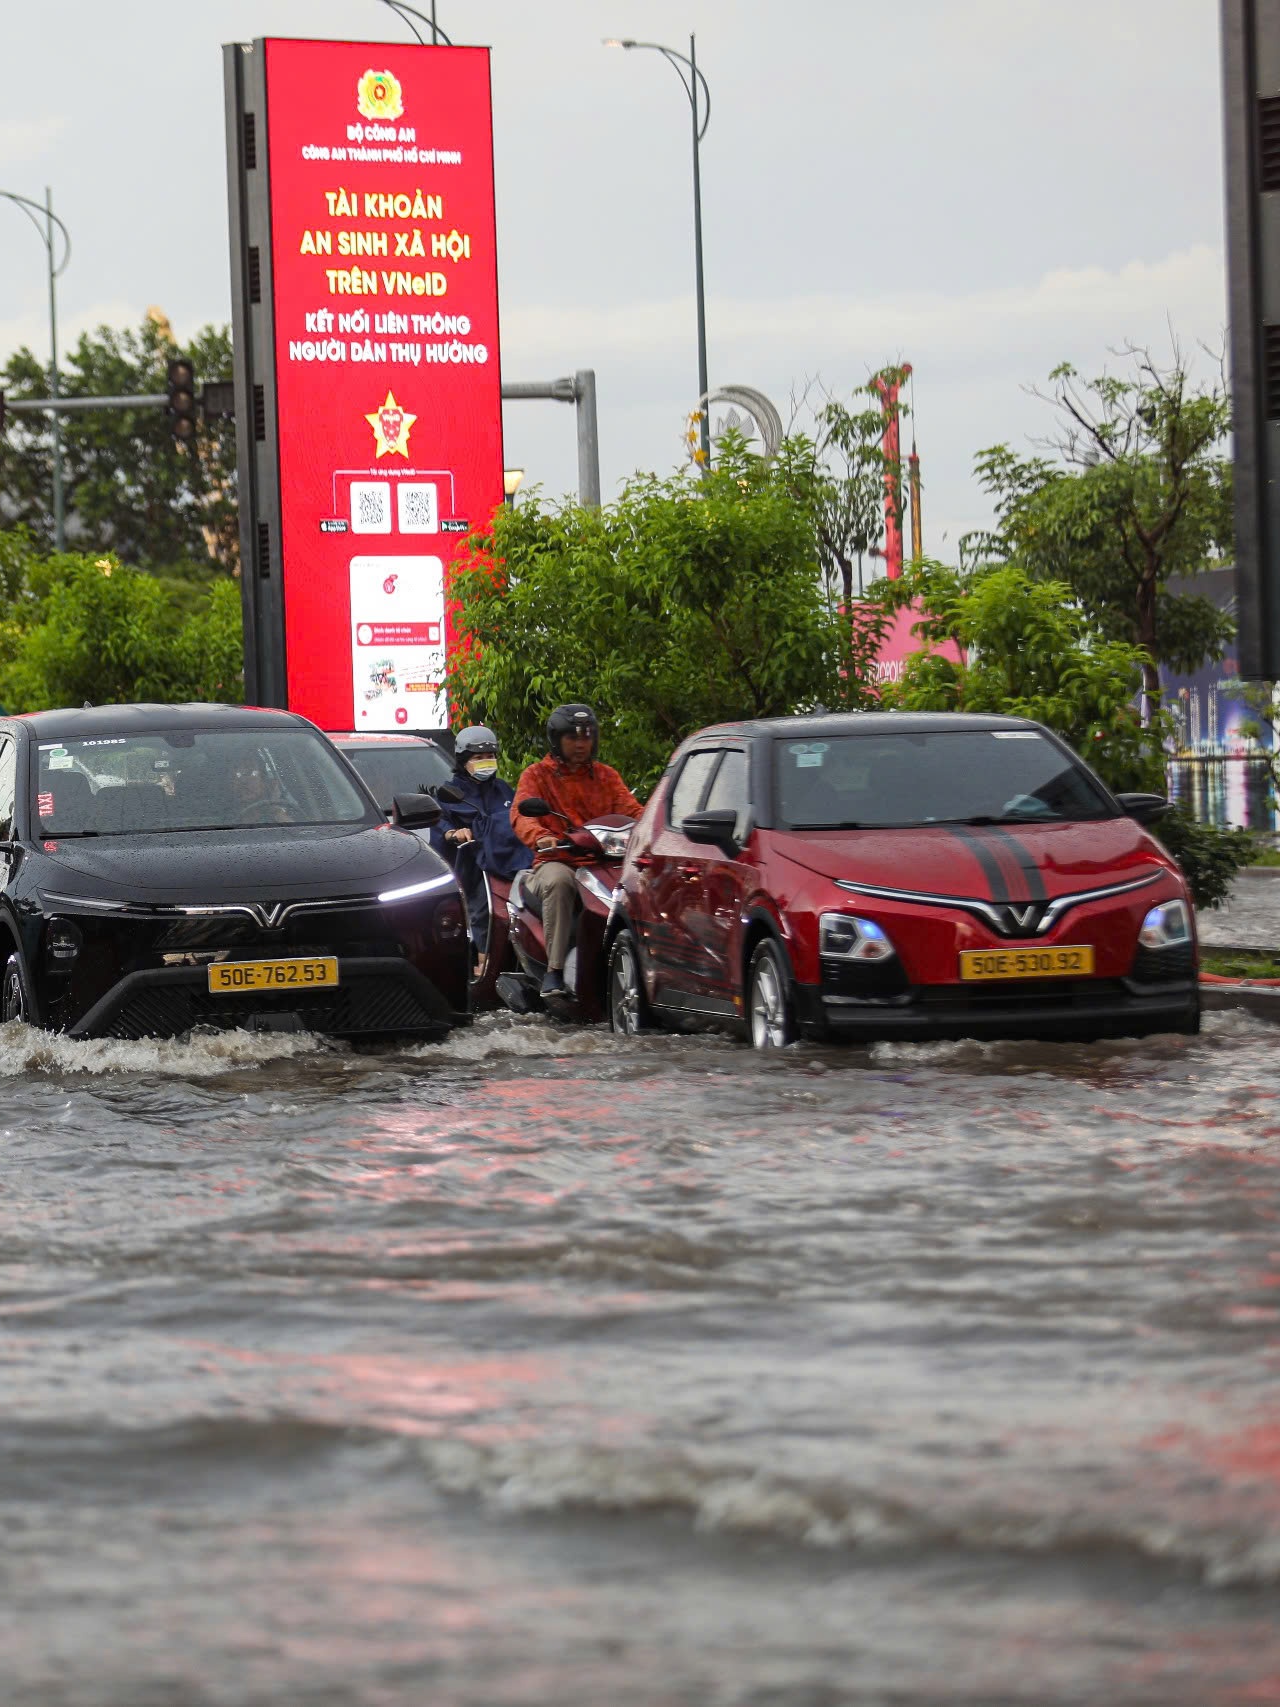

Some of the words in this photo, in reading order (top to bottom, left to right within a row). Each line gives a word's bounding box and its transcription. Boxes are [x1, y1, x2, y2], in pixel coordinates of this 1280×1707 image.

[398, 127, 416, 142] AN
[325, 187, 357, 217] TÀI
[364, 189, 442, 219] KHOẢN
[300, 230, 331, 256] AN
[337, 231, 388, 257] SINH
[394, 228, 425, 257] XÃ
[432, 230, 470, 263] HỘI
[326, 265, 377, 294] TRÊN
[382, 271, 447, 296] VNeID
[305, 307, 333, 334] KẾT
[338, 308, 370, 334] NỐI
[374, 310, 408, 334] LIÊN
[410, 311, 471, 335] THÔNG
[289, 337, 346, 362] NGƯỜI
[350, 338, 386, 363] DÂN
[389, 342, 421, 366] THỤ
[426, 338, 488, 364] HƯỞNG
[37, 793, 53, 816] TAXI
[220, 963, 327, 986] 50E-762.53
[972, 951, 1081, 974] 50E-530.92
